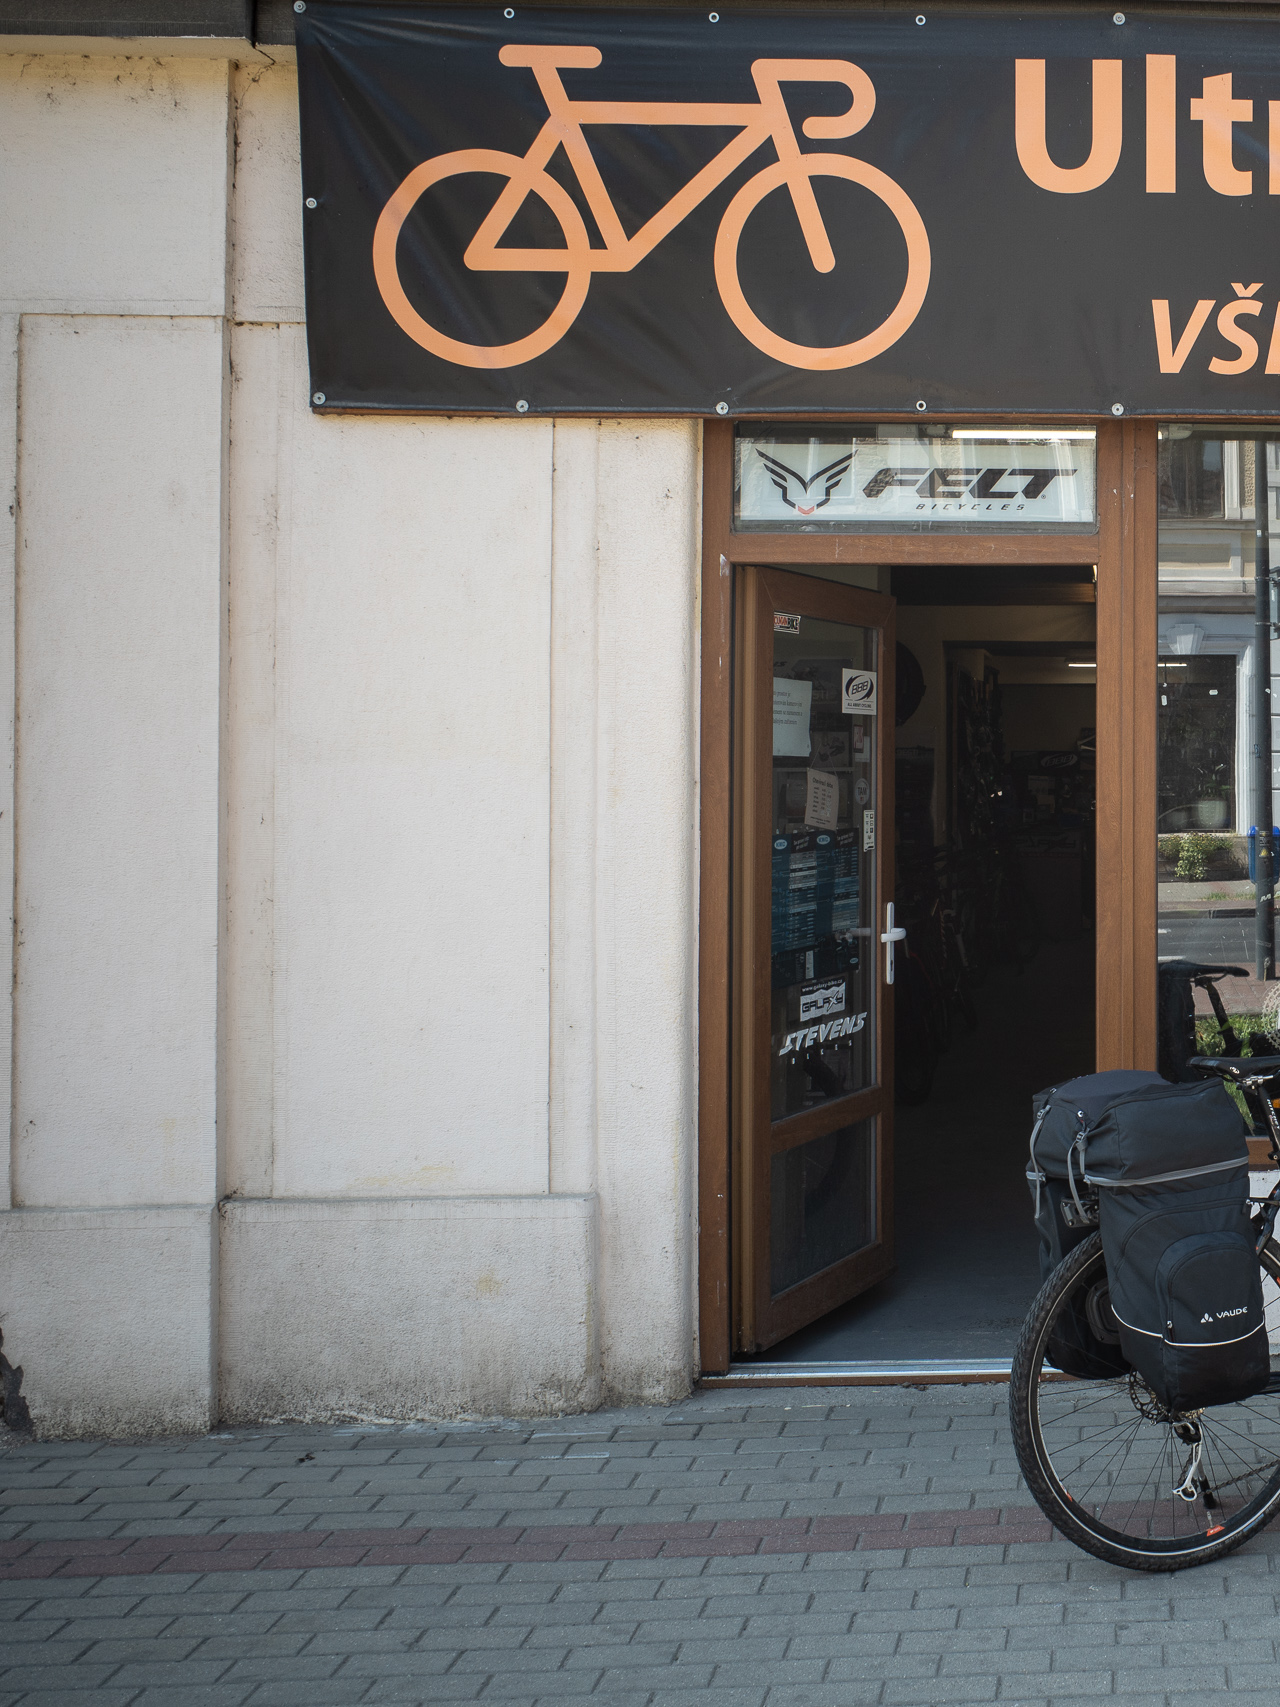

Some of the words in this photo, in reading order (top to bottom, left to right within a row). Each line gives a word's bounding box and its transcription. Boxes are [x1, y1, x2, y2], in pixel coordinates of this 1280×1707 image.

[862, 467, 1078, 499] FELT
[915, 503, 1025, 511] BICYCLES
[802, 989, 844, 1013] GALAXY
[779, 1011, 868, 1057] STEVENS
[1216, 1306, 1248, 1319] VAUDE
